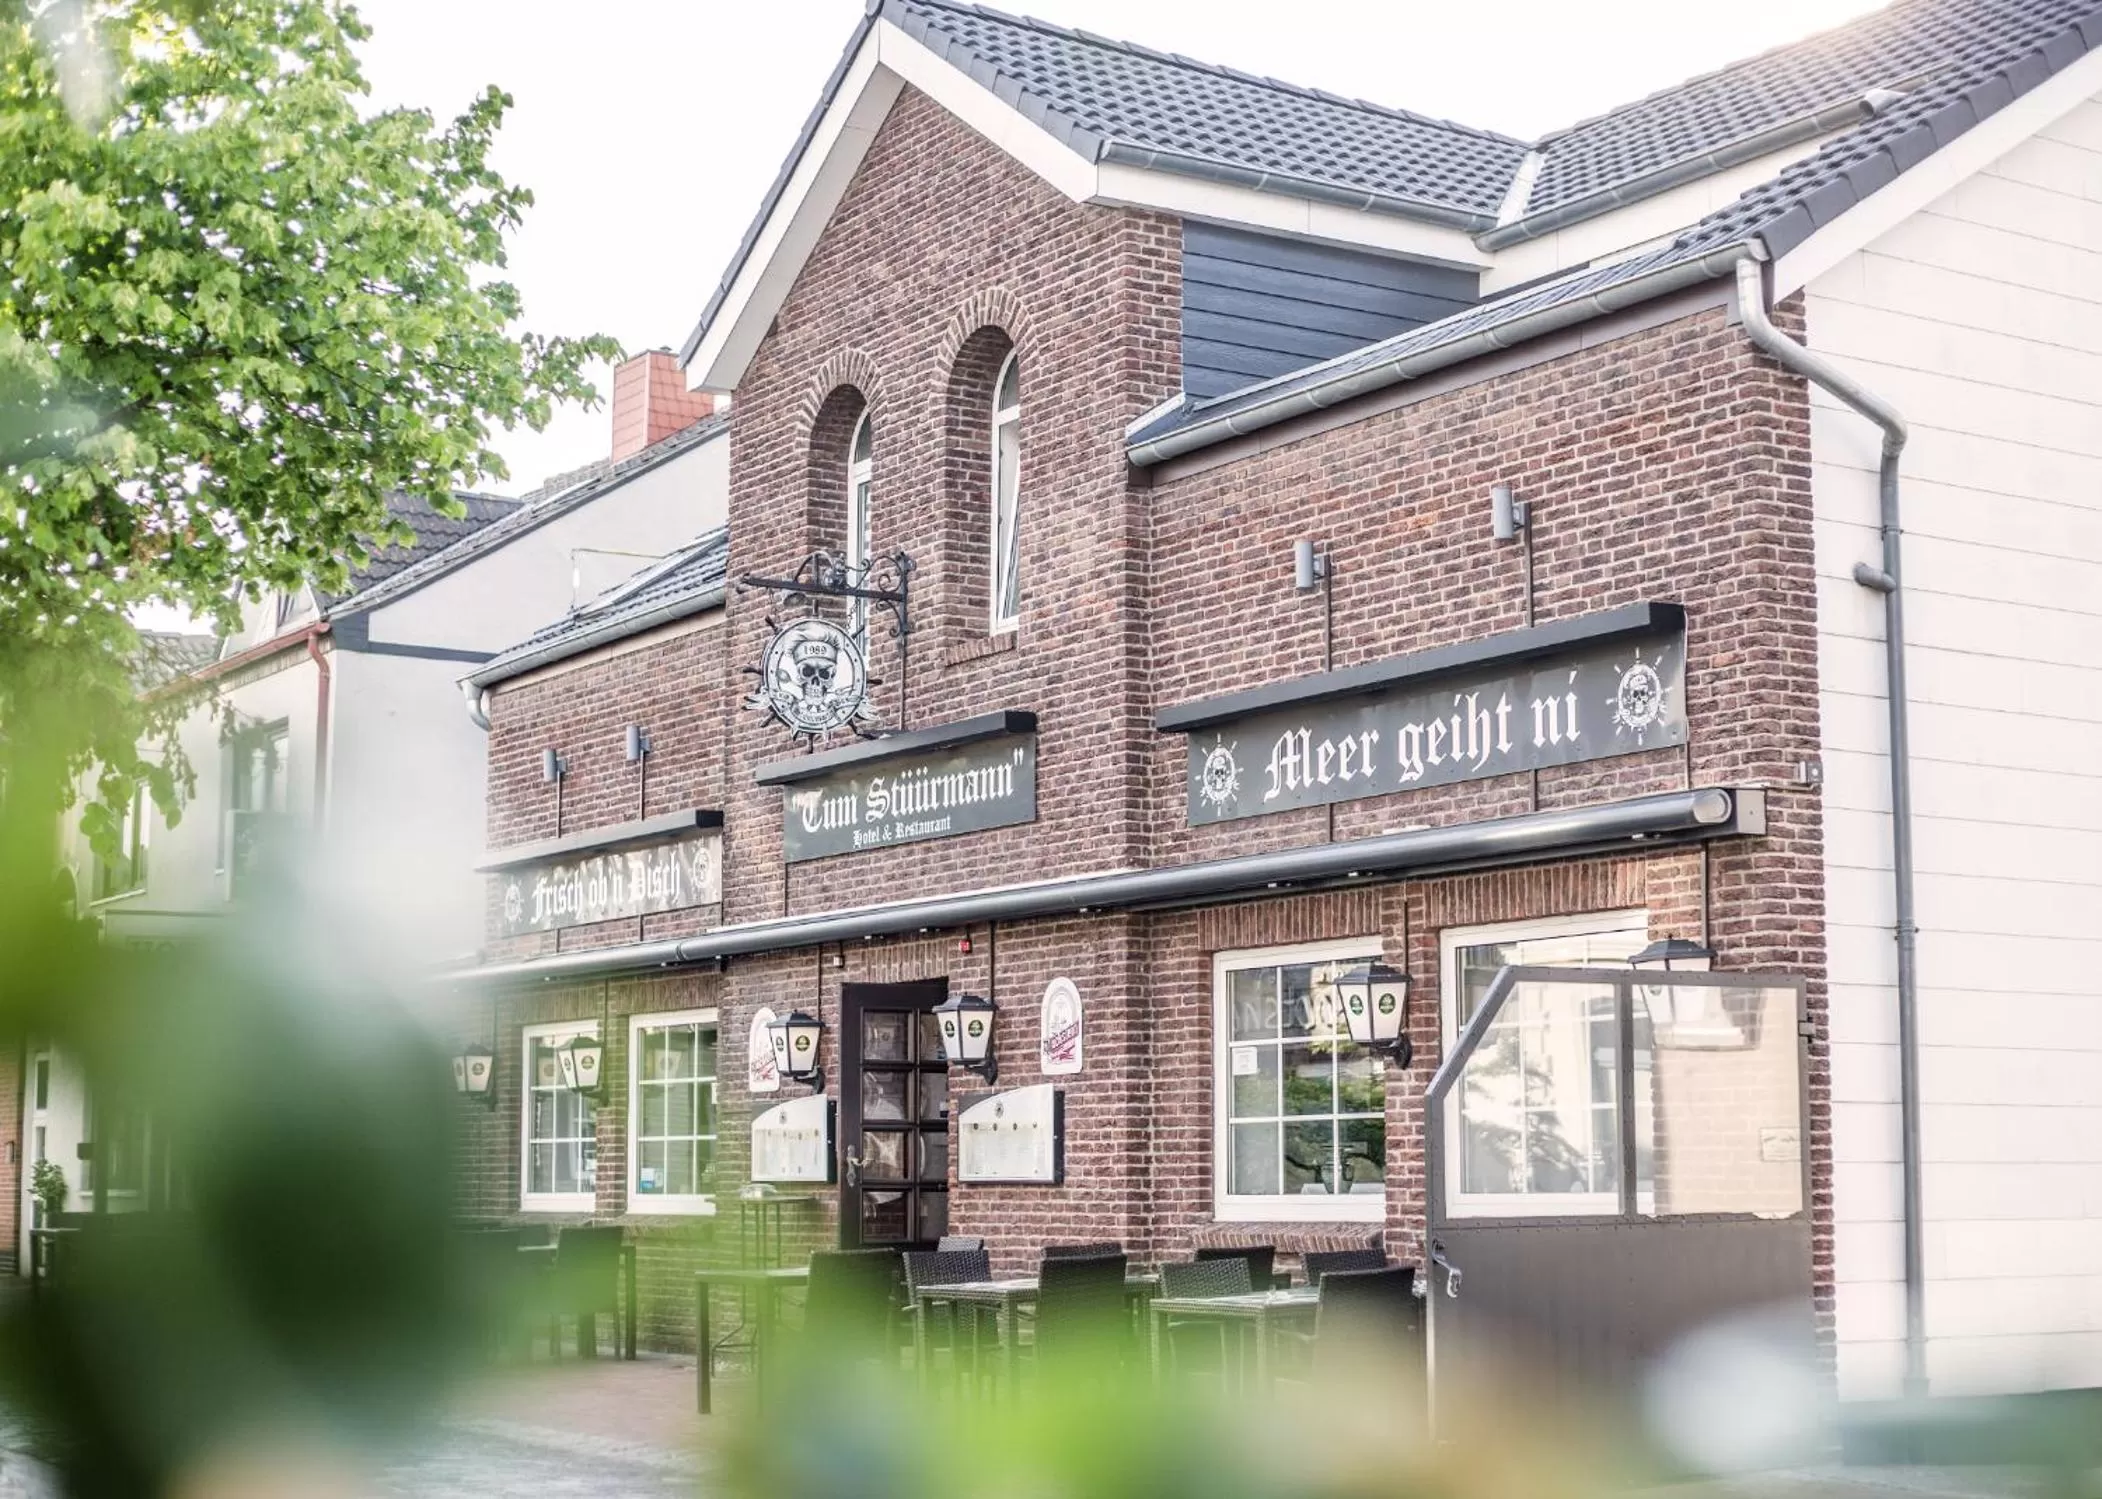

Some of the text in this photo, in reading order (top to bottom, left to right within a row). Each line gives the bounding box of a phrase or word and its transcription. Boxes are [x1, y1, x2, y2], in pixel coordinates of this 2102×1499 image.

[1263, 727, 1379, 803] Meer
[1397, 691, 1513, 784] geiht
[853, 816, 952, 849] Hotel & Restaurant
[627, 851, 681, 904] Disch
